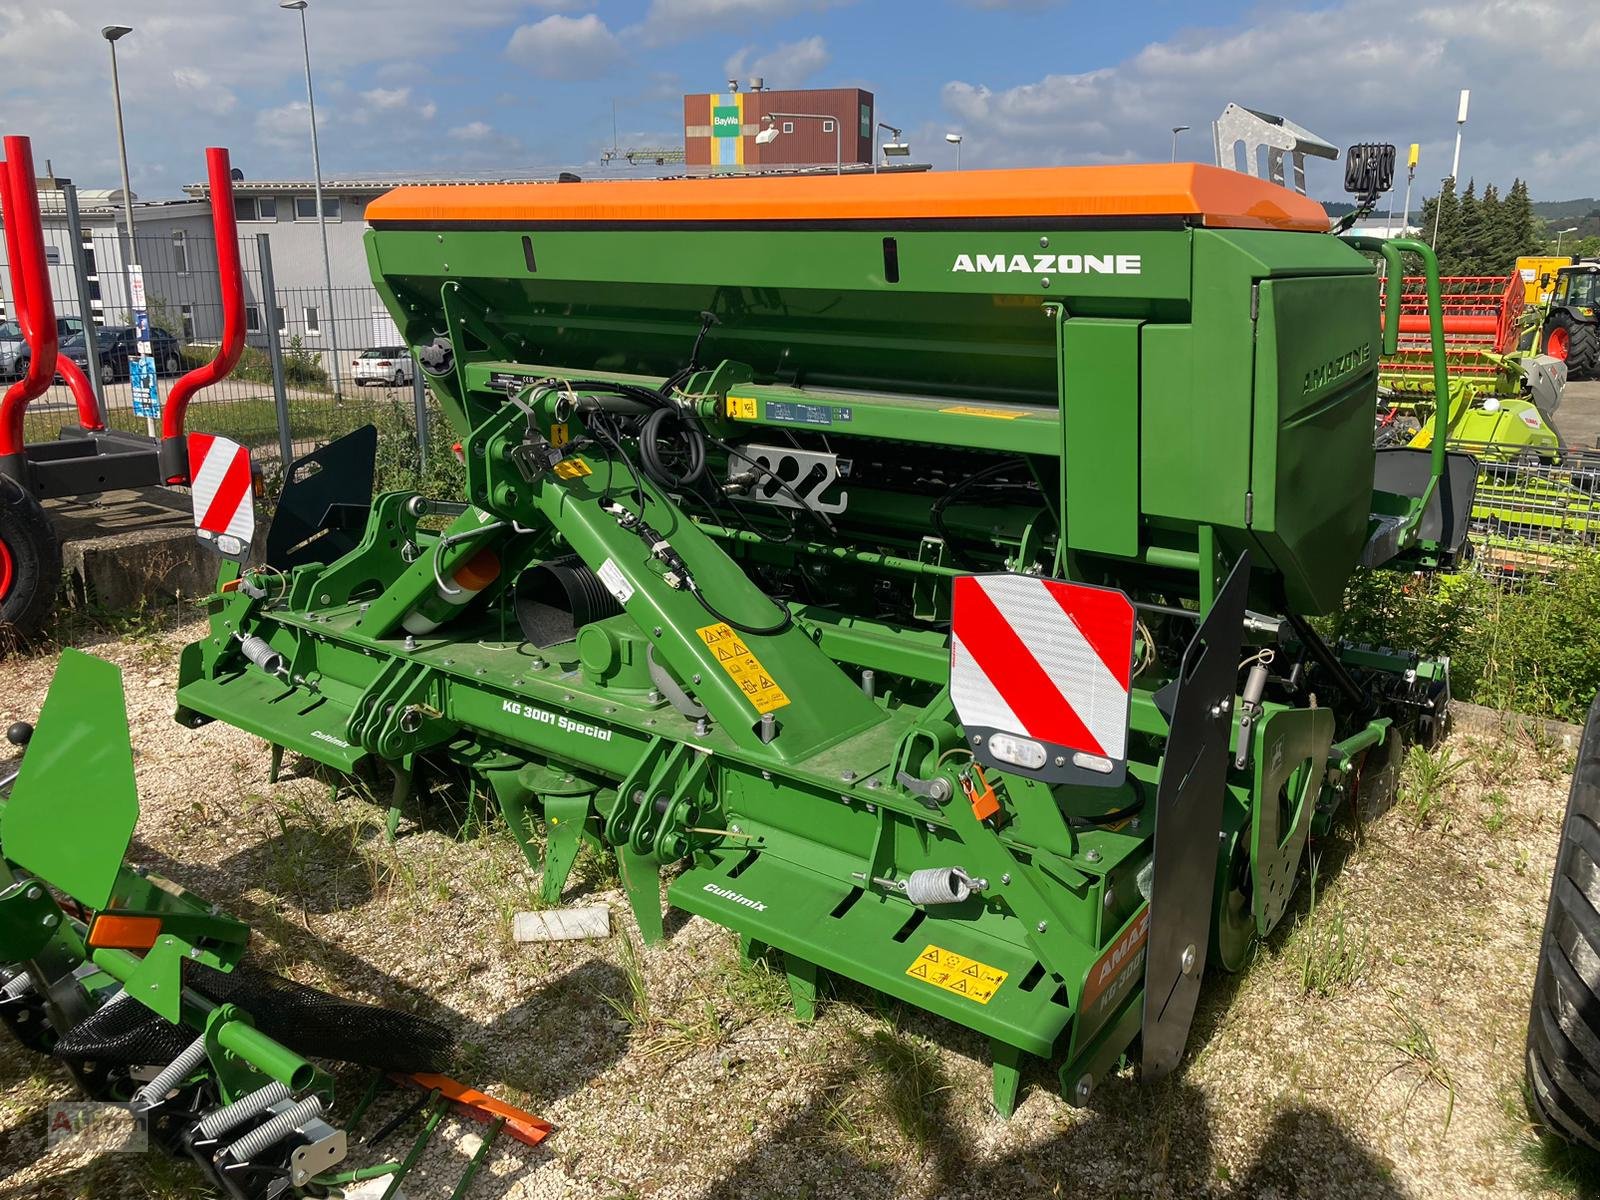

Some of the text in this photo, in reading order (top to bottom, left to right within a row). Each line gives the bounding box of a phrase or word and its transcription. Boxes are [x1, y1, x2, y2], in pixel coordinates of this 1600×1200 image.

[714, 116, 738, 126] BayWa
[952, 254, 1142, 274] AMAZONE
[1303, 342, 1370, 395] AMAZONE
[502, 700, 613, 742] KG 3001 Special
[310, 730, 350, 748] Cultimix
[703, 883, 768, 912] Cultimix
